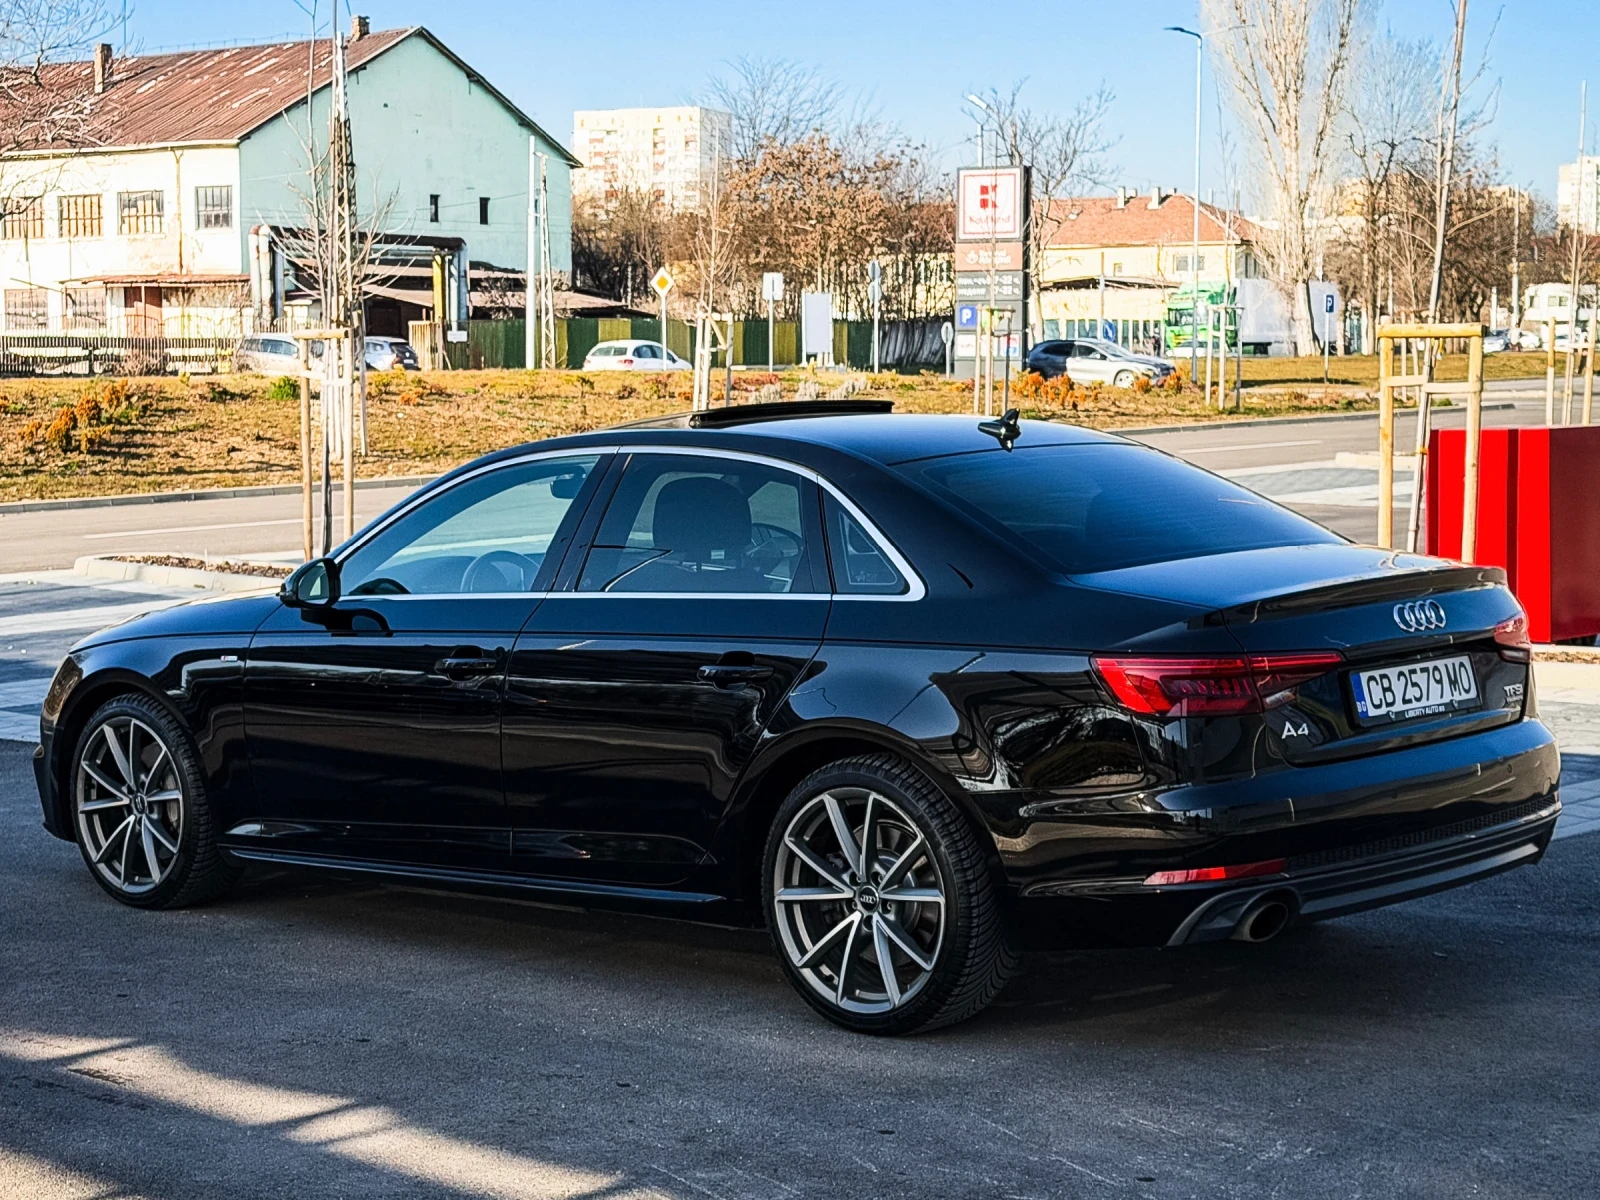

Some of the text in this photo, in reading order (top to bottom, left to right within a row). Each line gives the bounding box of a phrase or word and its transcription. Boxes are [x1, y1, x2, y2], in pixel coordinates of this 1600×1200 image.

[961, 308, 972, 324] P
[1366, 661, 1471, 710] CB 2579 MO
[1357, 701, 1367, 713] BG
[1281, 720, 1309, 740] A4
